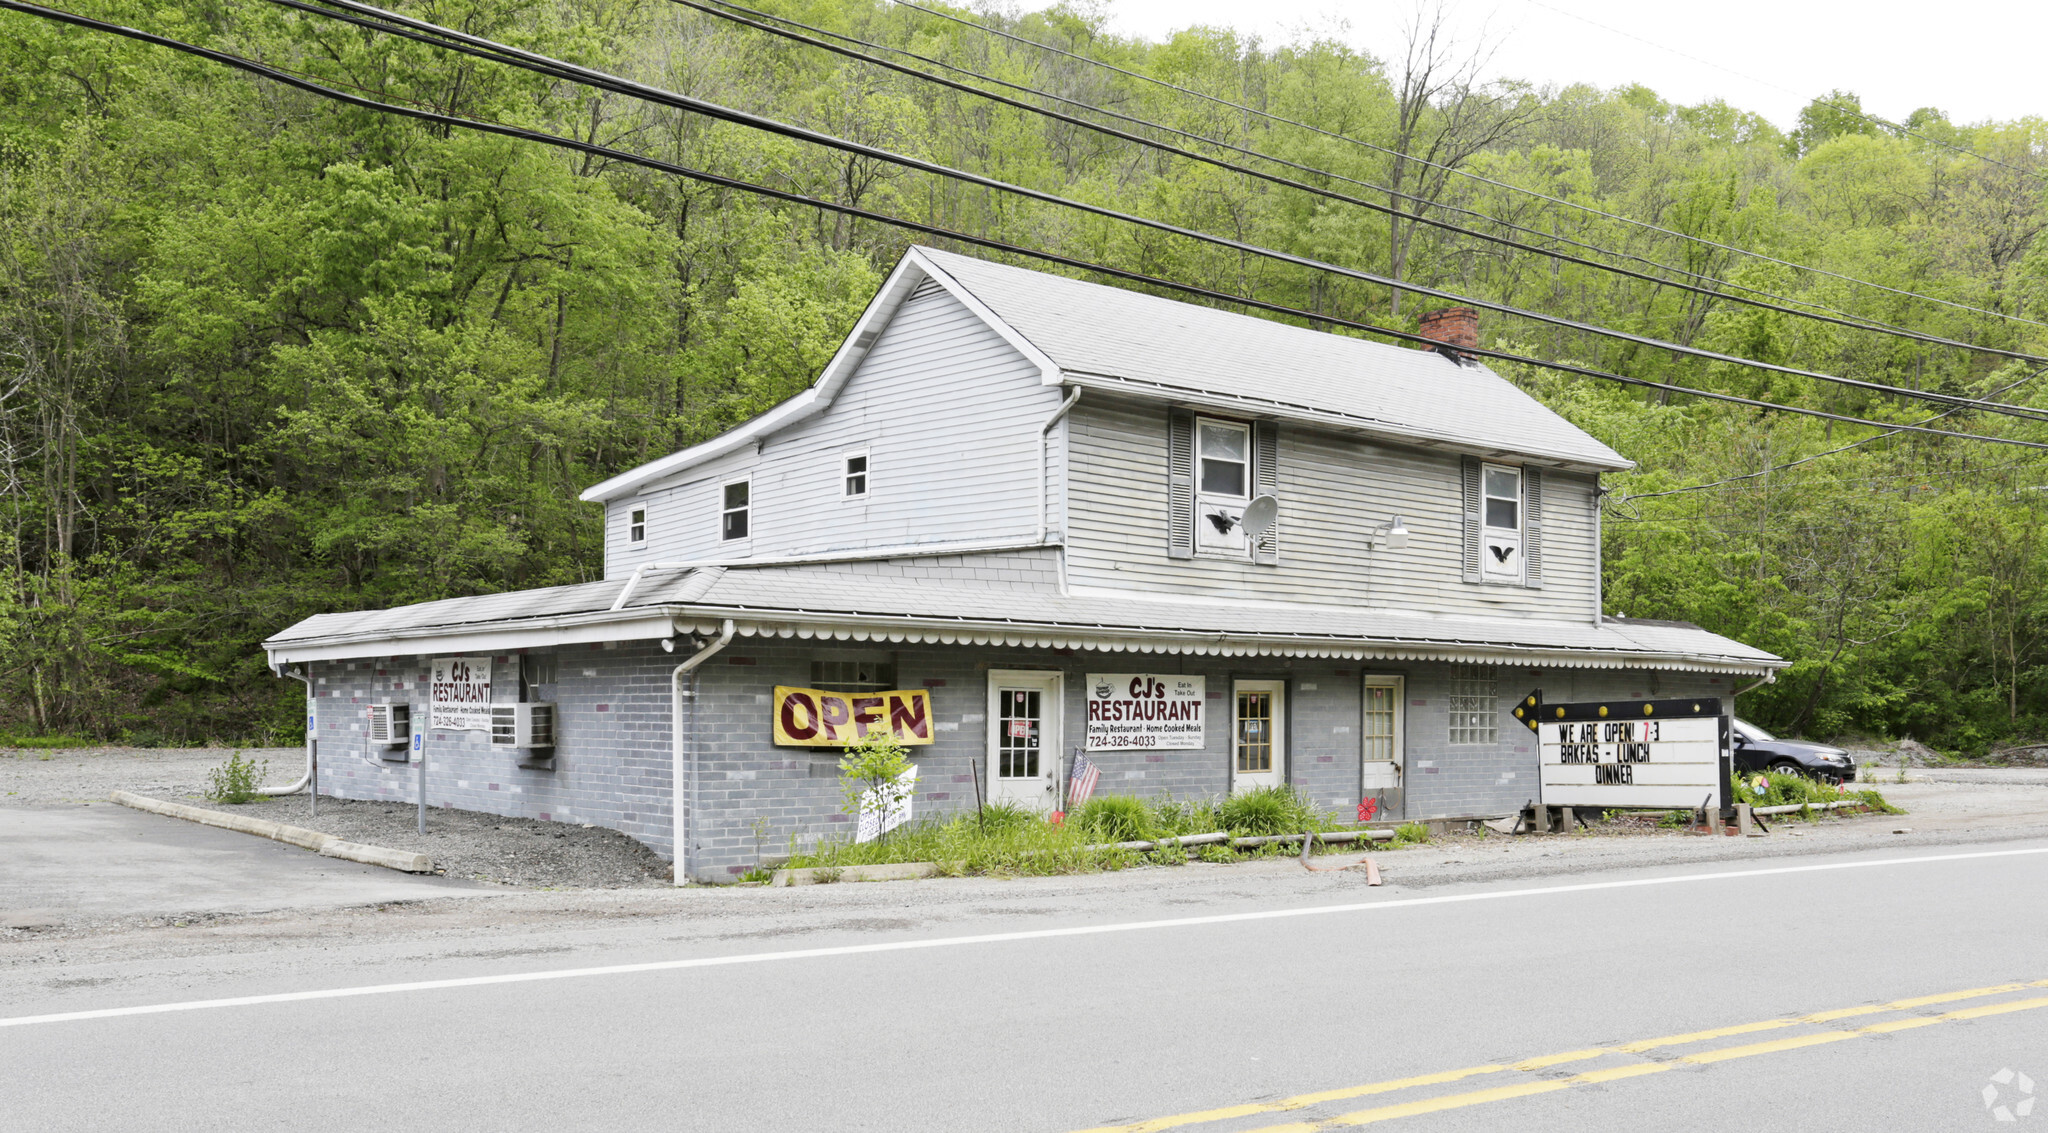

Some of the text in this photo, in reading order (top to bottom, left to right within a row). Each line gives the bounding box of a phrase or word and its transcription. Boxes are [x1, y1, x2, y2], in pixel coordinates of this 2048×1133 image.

[452, 661, 471, 682] CJ's
[433, 682, 490, 703] RESTAURANT
[1129, 676, 1165, 699] CJ's
[781, 692, 929, 741] OPEN
[1089, 700, 1201, 721] RESTAURANT
[1089, 723, 1201, 735] Family Restaurant Home Cooked Meals
[1559, 724, 1574, 743] WE
[1580, 723, 1598, 743] ARE
[1604, 722, 1635, 742] OPEN!
[1089, 735, 1156, 747] 724-326-4033
[1561, 745, 1599, 763] BRKFAS
[1617, 743, 1650, 763] LUNCH
[1595, 765, 1633, 784] DINNER
